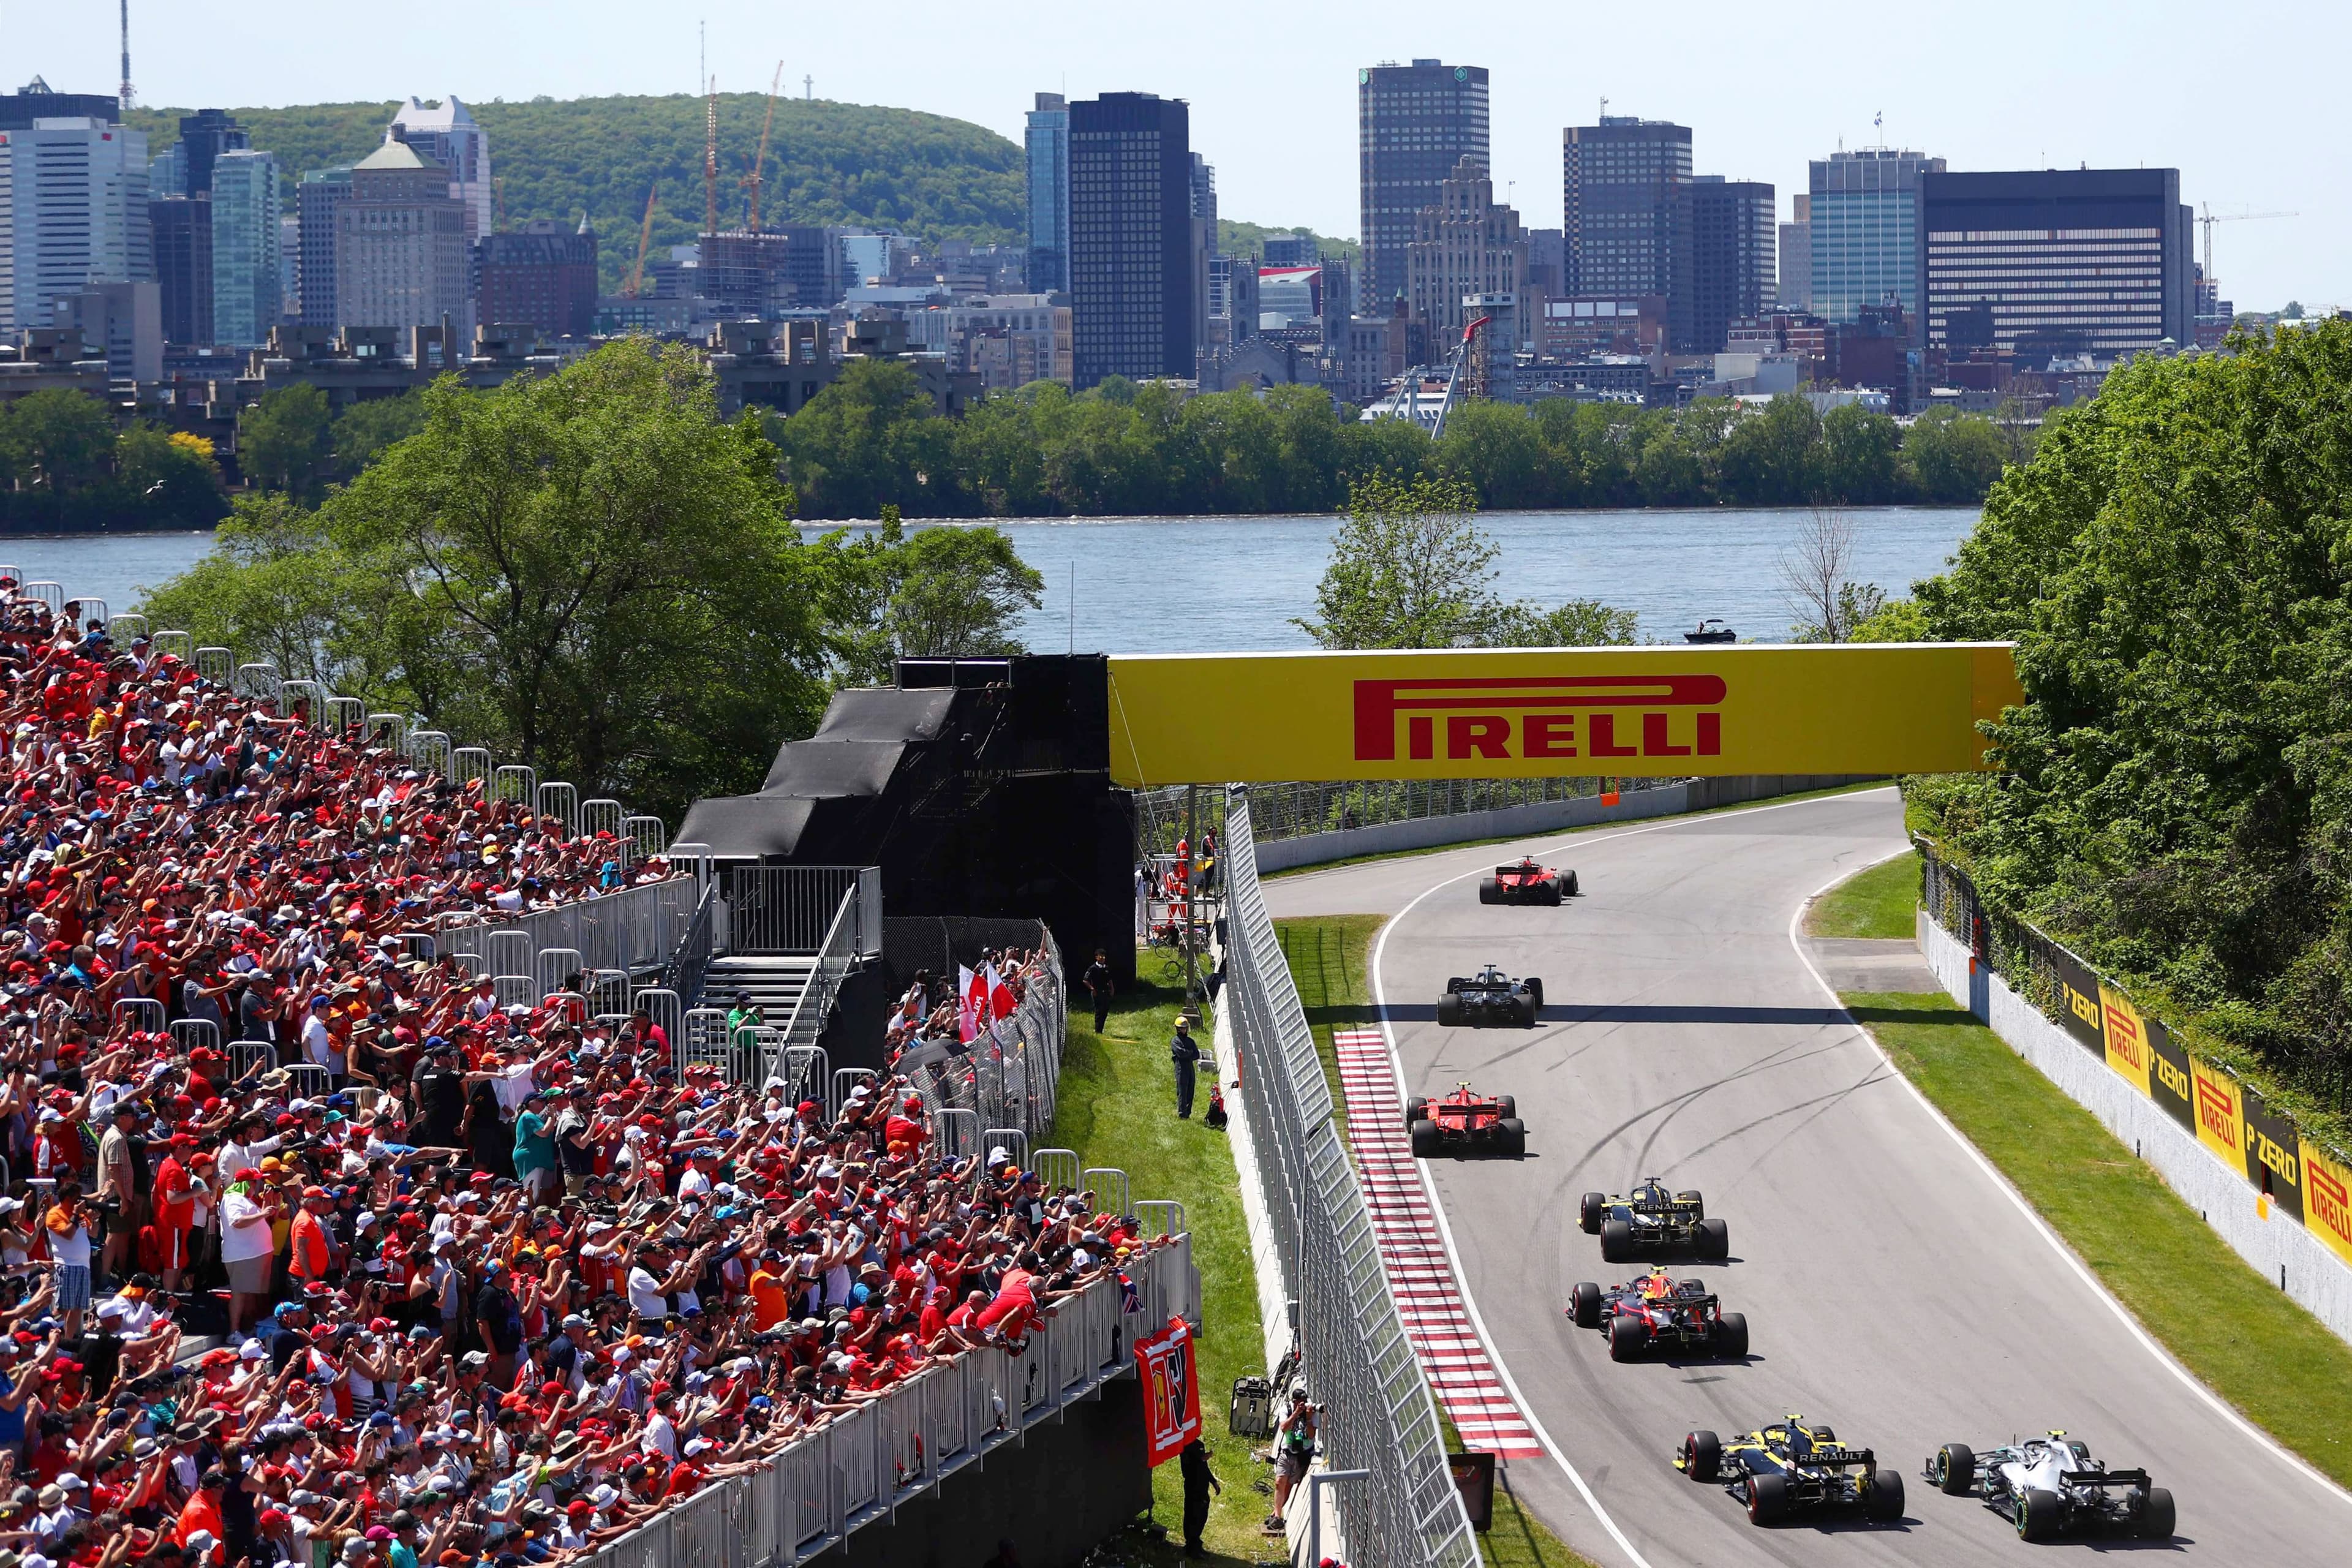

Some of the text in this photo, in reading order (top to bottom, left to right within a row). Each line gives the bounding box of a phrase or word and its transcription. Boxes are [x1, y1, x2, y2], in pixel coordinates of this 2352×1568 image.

[1354, 674, 1727, 761] PIRELLI
[2062, 981, 2099, 1030] P ZERO
[2105, 1003, 2141, 1071] PIRELLI
[2149, 1045, 2188, 1102] P ZERO
[2196, 1074, 2236, 1150] PIRELLI
[2247, 1122, 2296, 1186] P ZERO
[2307, 1158, 2352, 1245] PIRELLI
[1800, 1452, 1866, 1462] RENAULT
